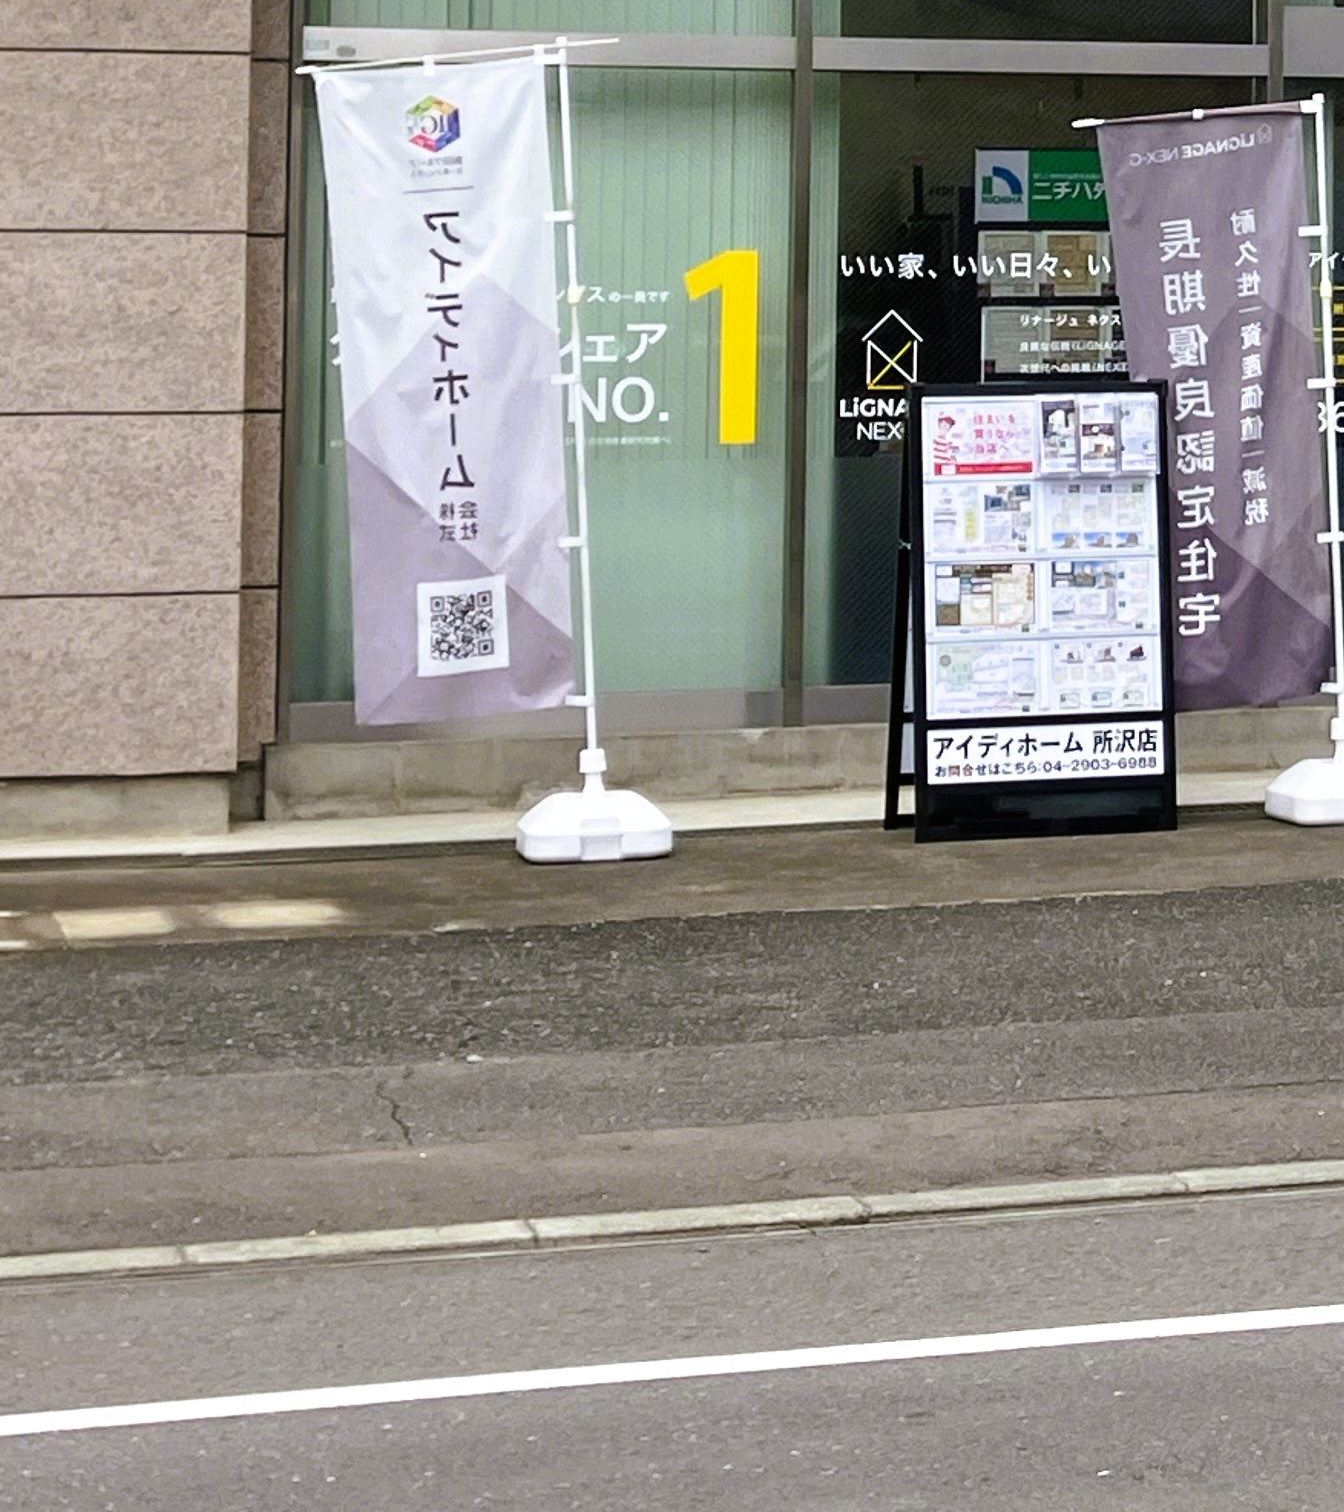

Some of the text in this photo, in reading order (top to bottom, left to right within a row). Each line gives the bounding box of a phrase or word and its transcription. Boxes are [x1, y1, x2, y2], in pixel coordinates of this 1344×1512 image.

[1020, 313, 1079, 328] リナージュ
[683, 248, 759, 445] 1
[566, 375, 670, 424] NO.
[932, 728, 1158, 760] アイディホーム 所沢店
